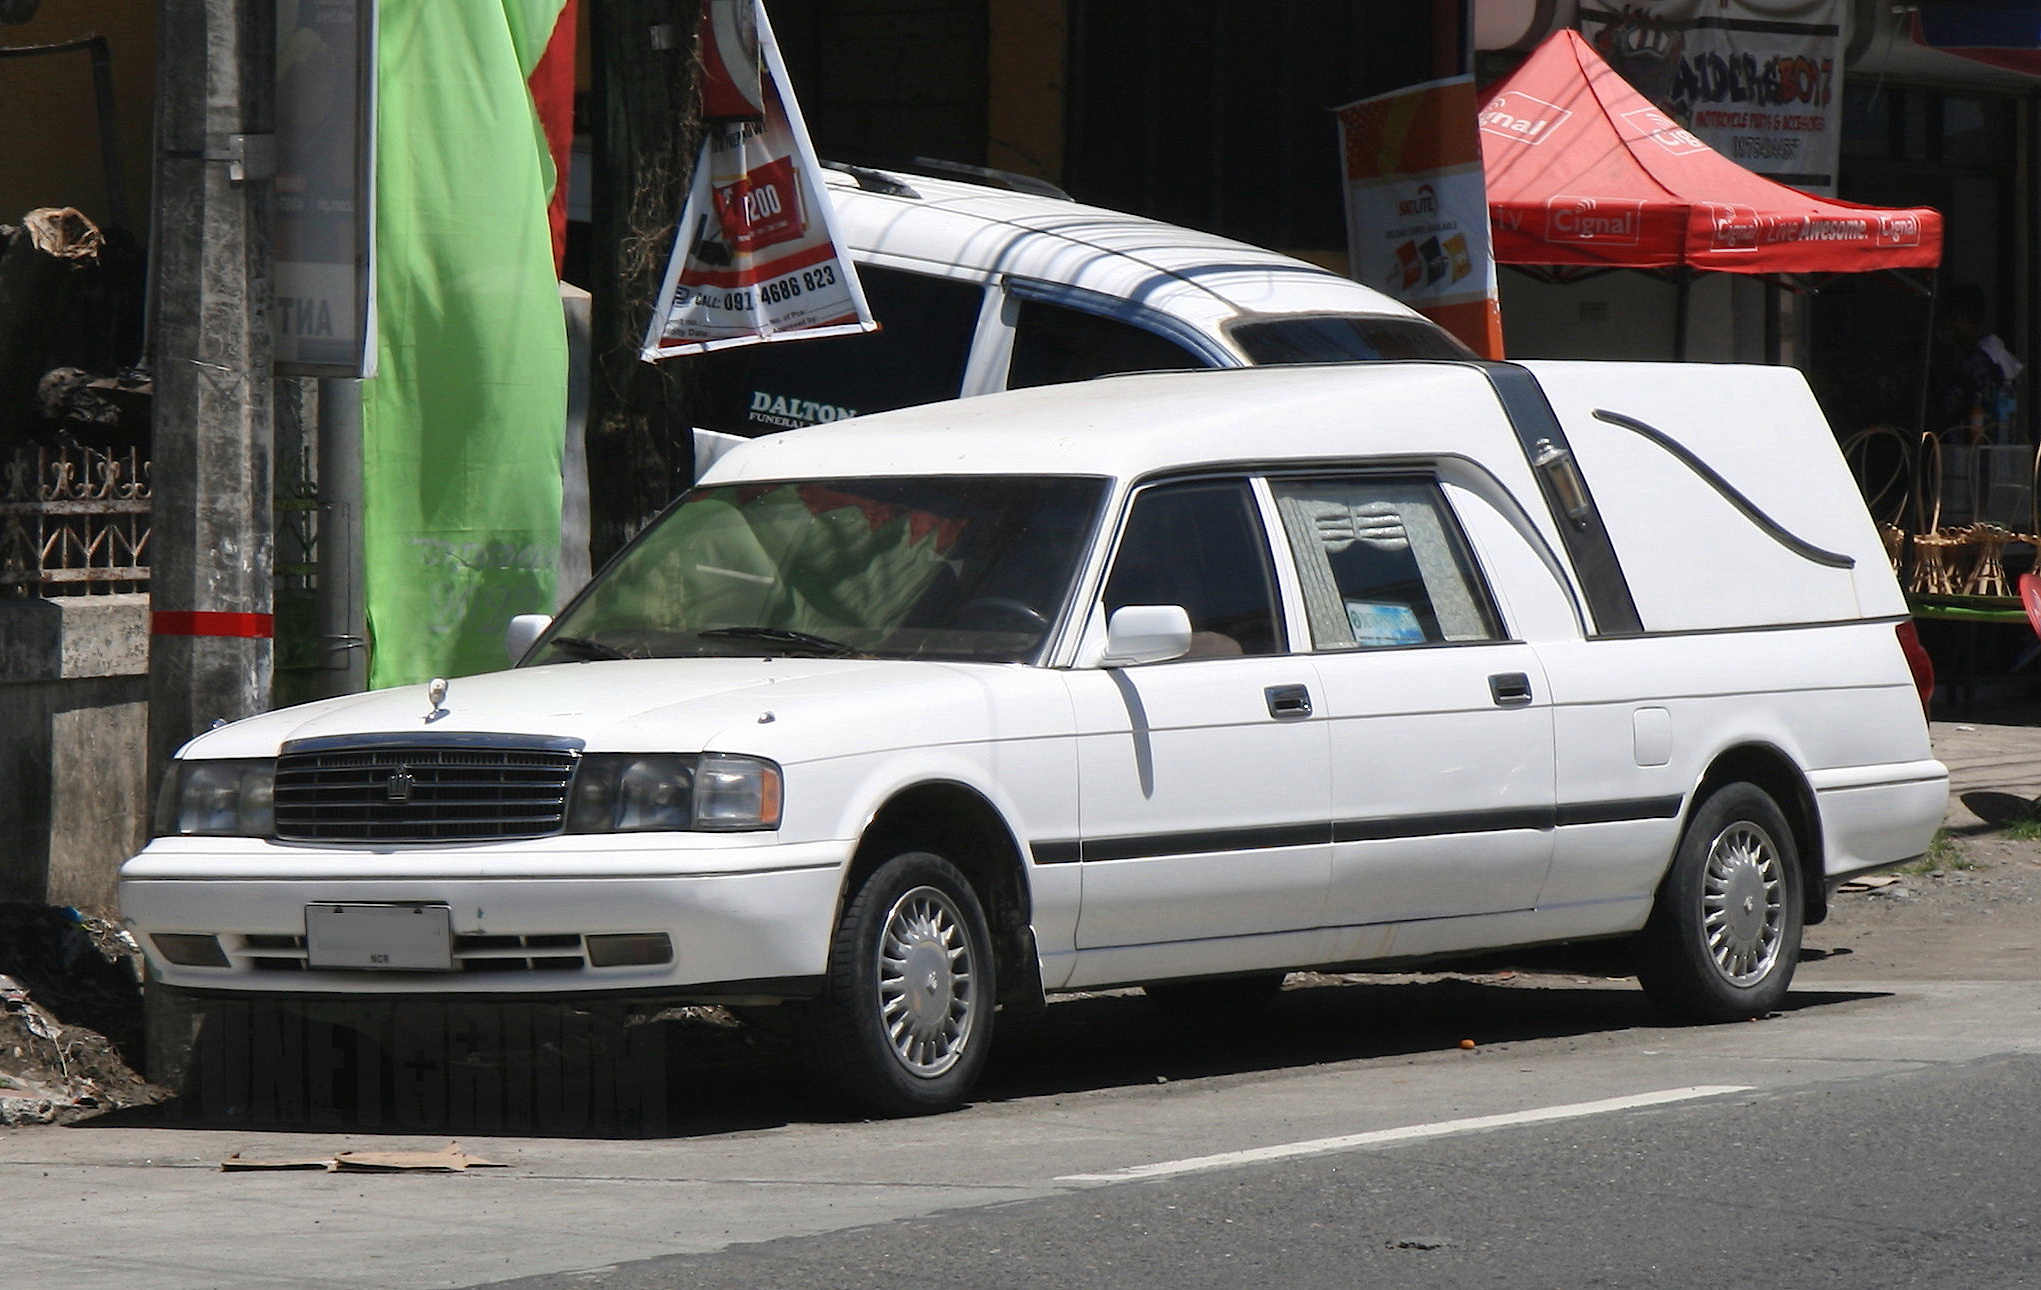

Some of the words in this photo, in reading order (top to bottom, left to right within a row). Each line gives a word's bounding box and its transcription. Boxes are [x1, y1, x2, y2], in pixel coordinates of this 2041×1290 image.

[1553, 206, 1633, 238] Cignal
[1880, 214, 1917, 242] Cignal
[803, 265, 836, 292] 823
[750, 391, 857, 423] DALTON
